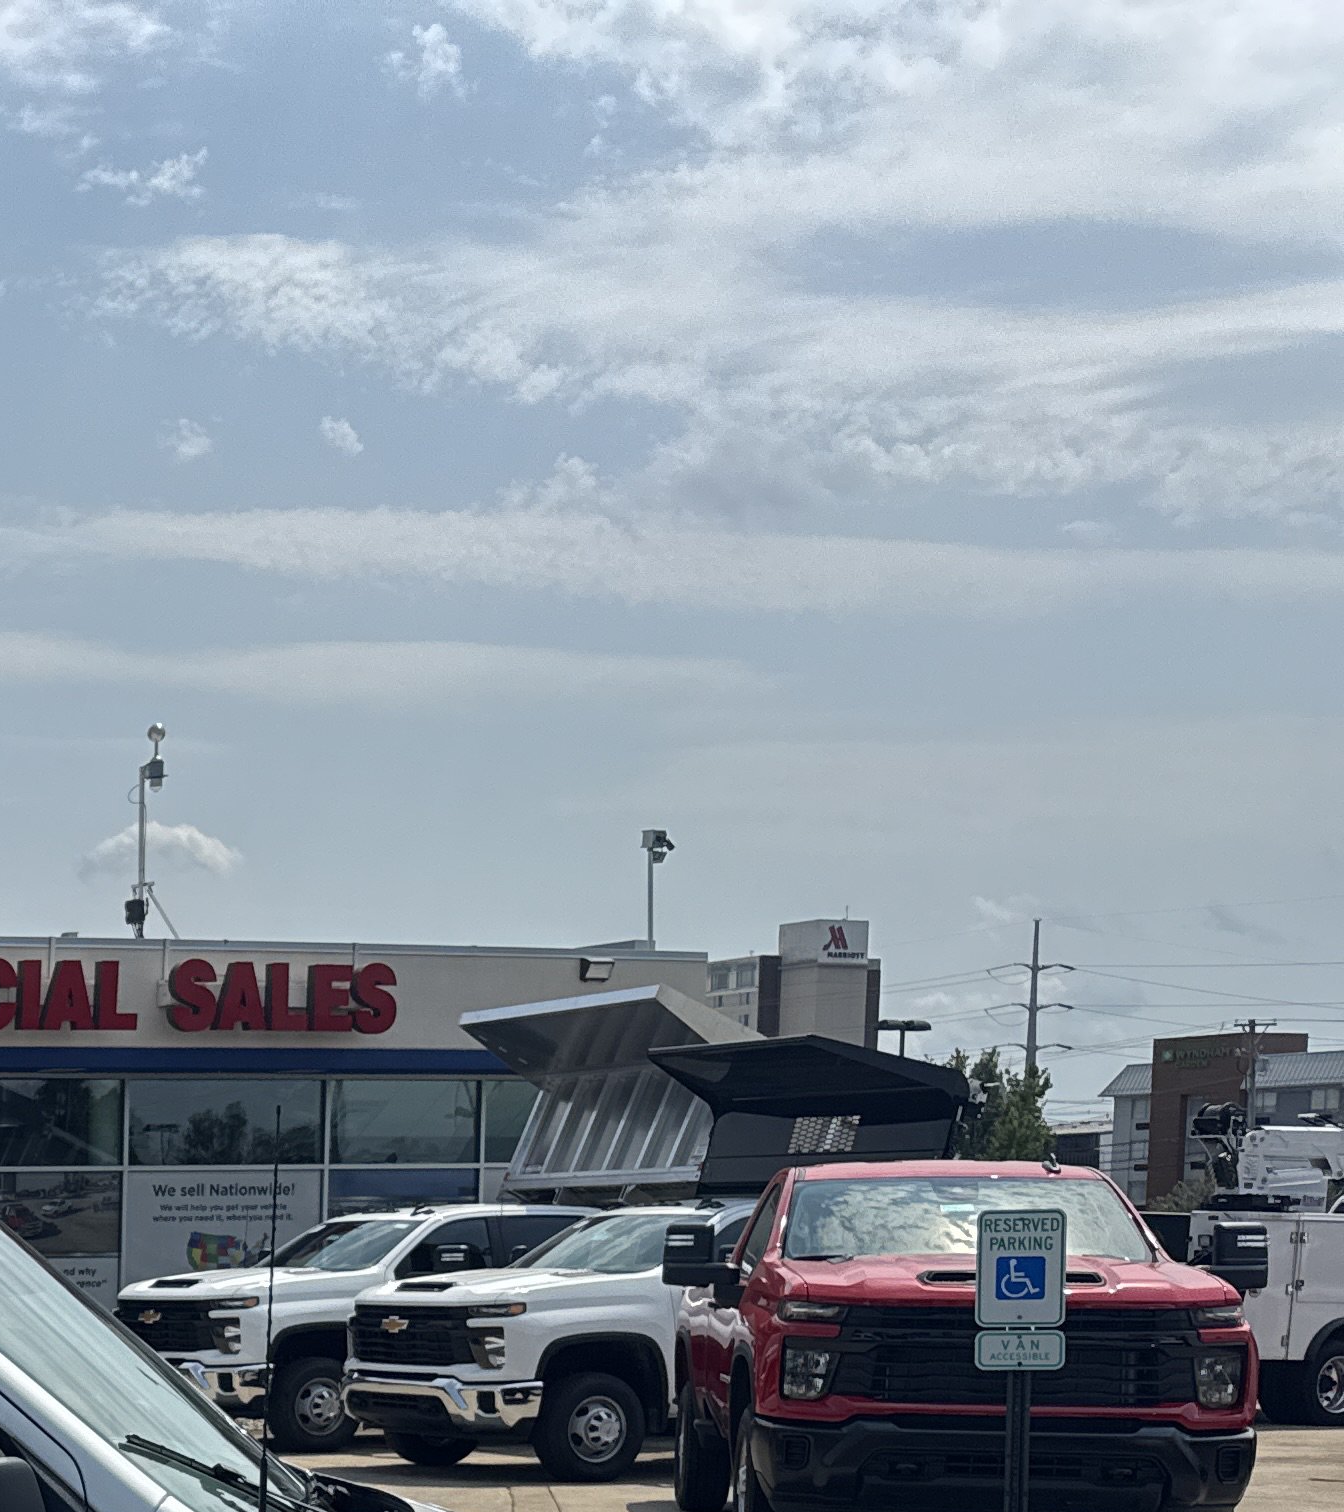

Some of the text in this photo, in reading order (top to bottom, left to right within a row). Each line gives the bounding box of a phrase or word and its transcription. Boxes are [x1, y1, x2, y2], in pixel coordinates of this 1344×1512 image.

[166, 957, 397, 1035] SALES
[152, 1182, 295, 1197] We sell Nationwide!
[190, 1204, 207, 1212] help
[210, 1204, 223, 1212] you
[241, 1204, 258, 1212] your
[983, 1217, 1060, 1233] RESERVED
[990, 1236, 1054, 1251] PARKING
[78, 1266, 97, 1277] why
[1001, 1339, 1040, 1350] VAN
[989, 1352, 1050, 1361] ACCESSIBLE
